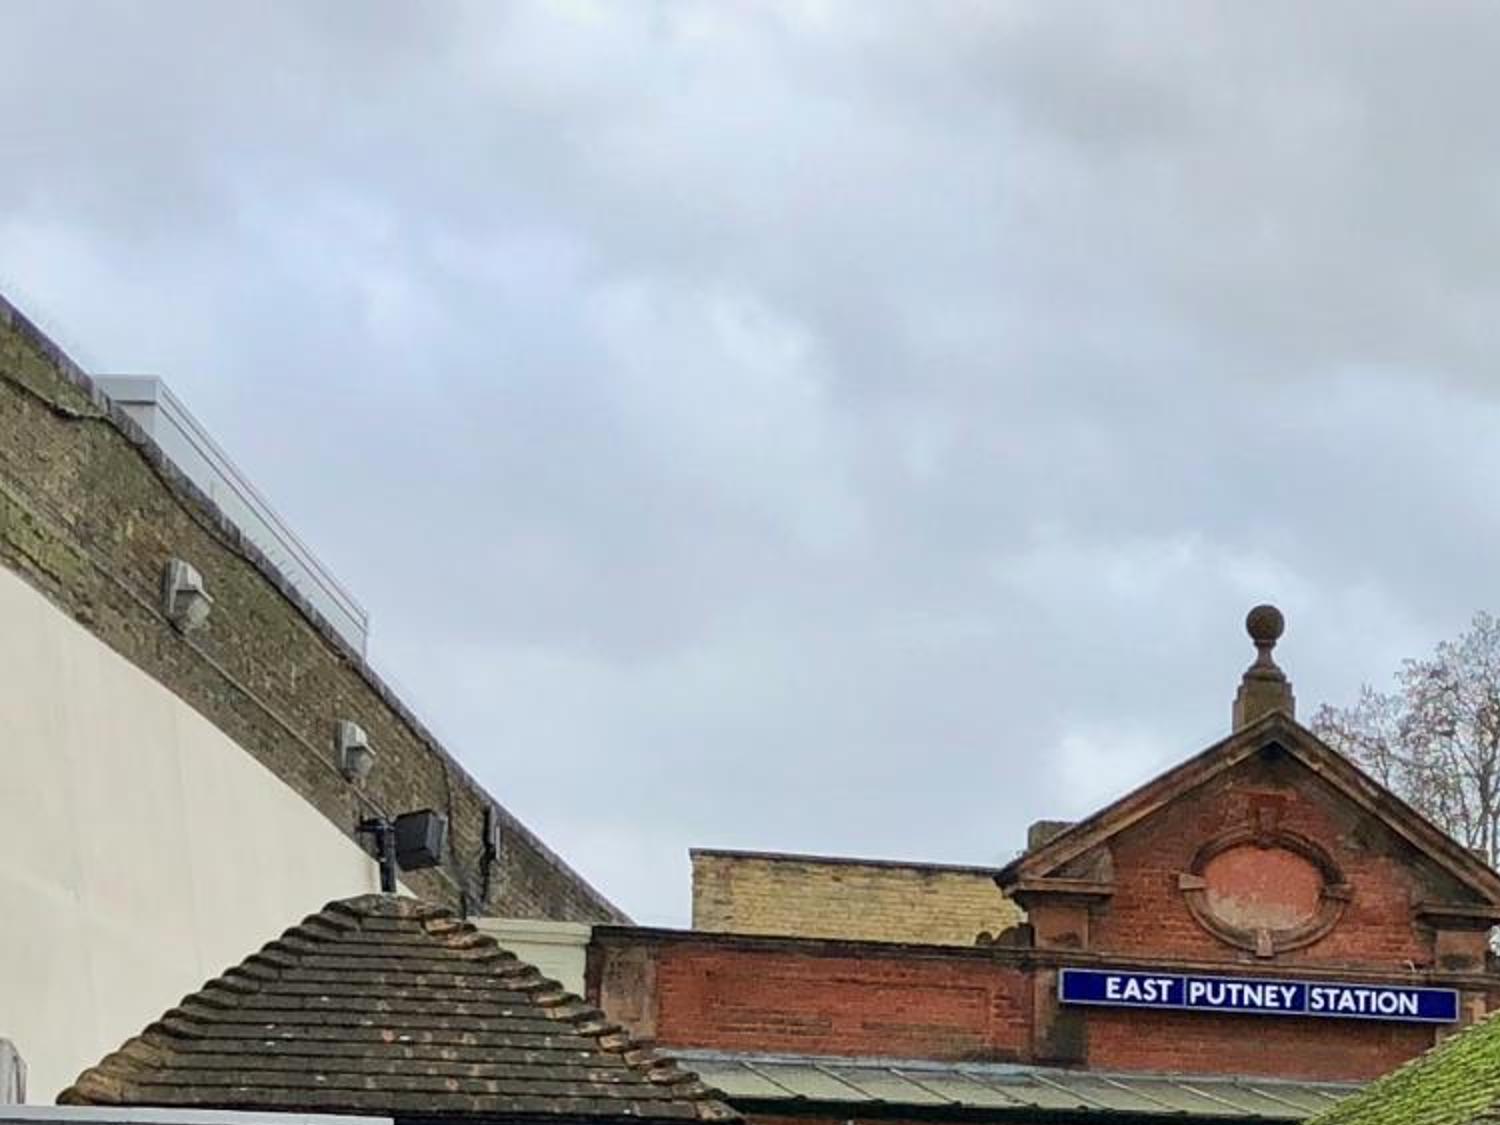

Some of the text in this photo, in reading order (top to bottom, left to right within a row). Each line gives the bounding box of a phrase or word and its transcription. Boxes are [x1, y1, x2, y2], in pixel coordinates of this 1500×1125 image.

[1105, 976, 1419, 1016] EAST PUTNEY STATION
